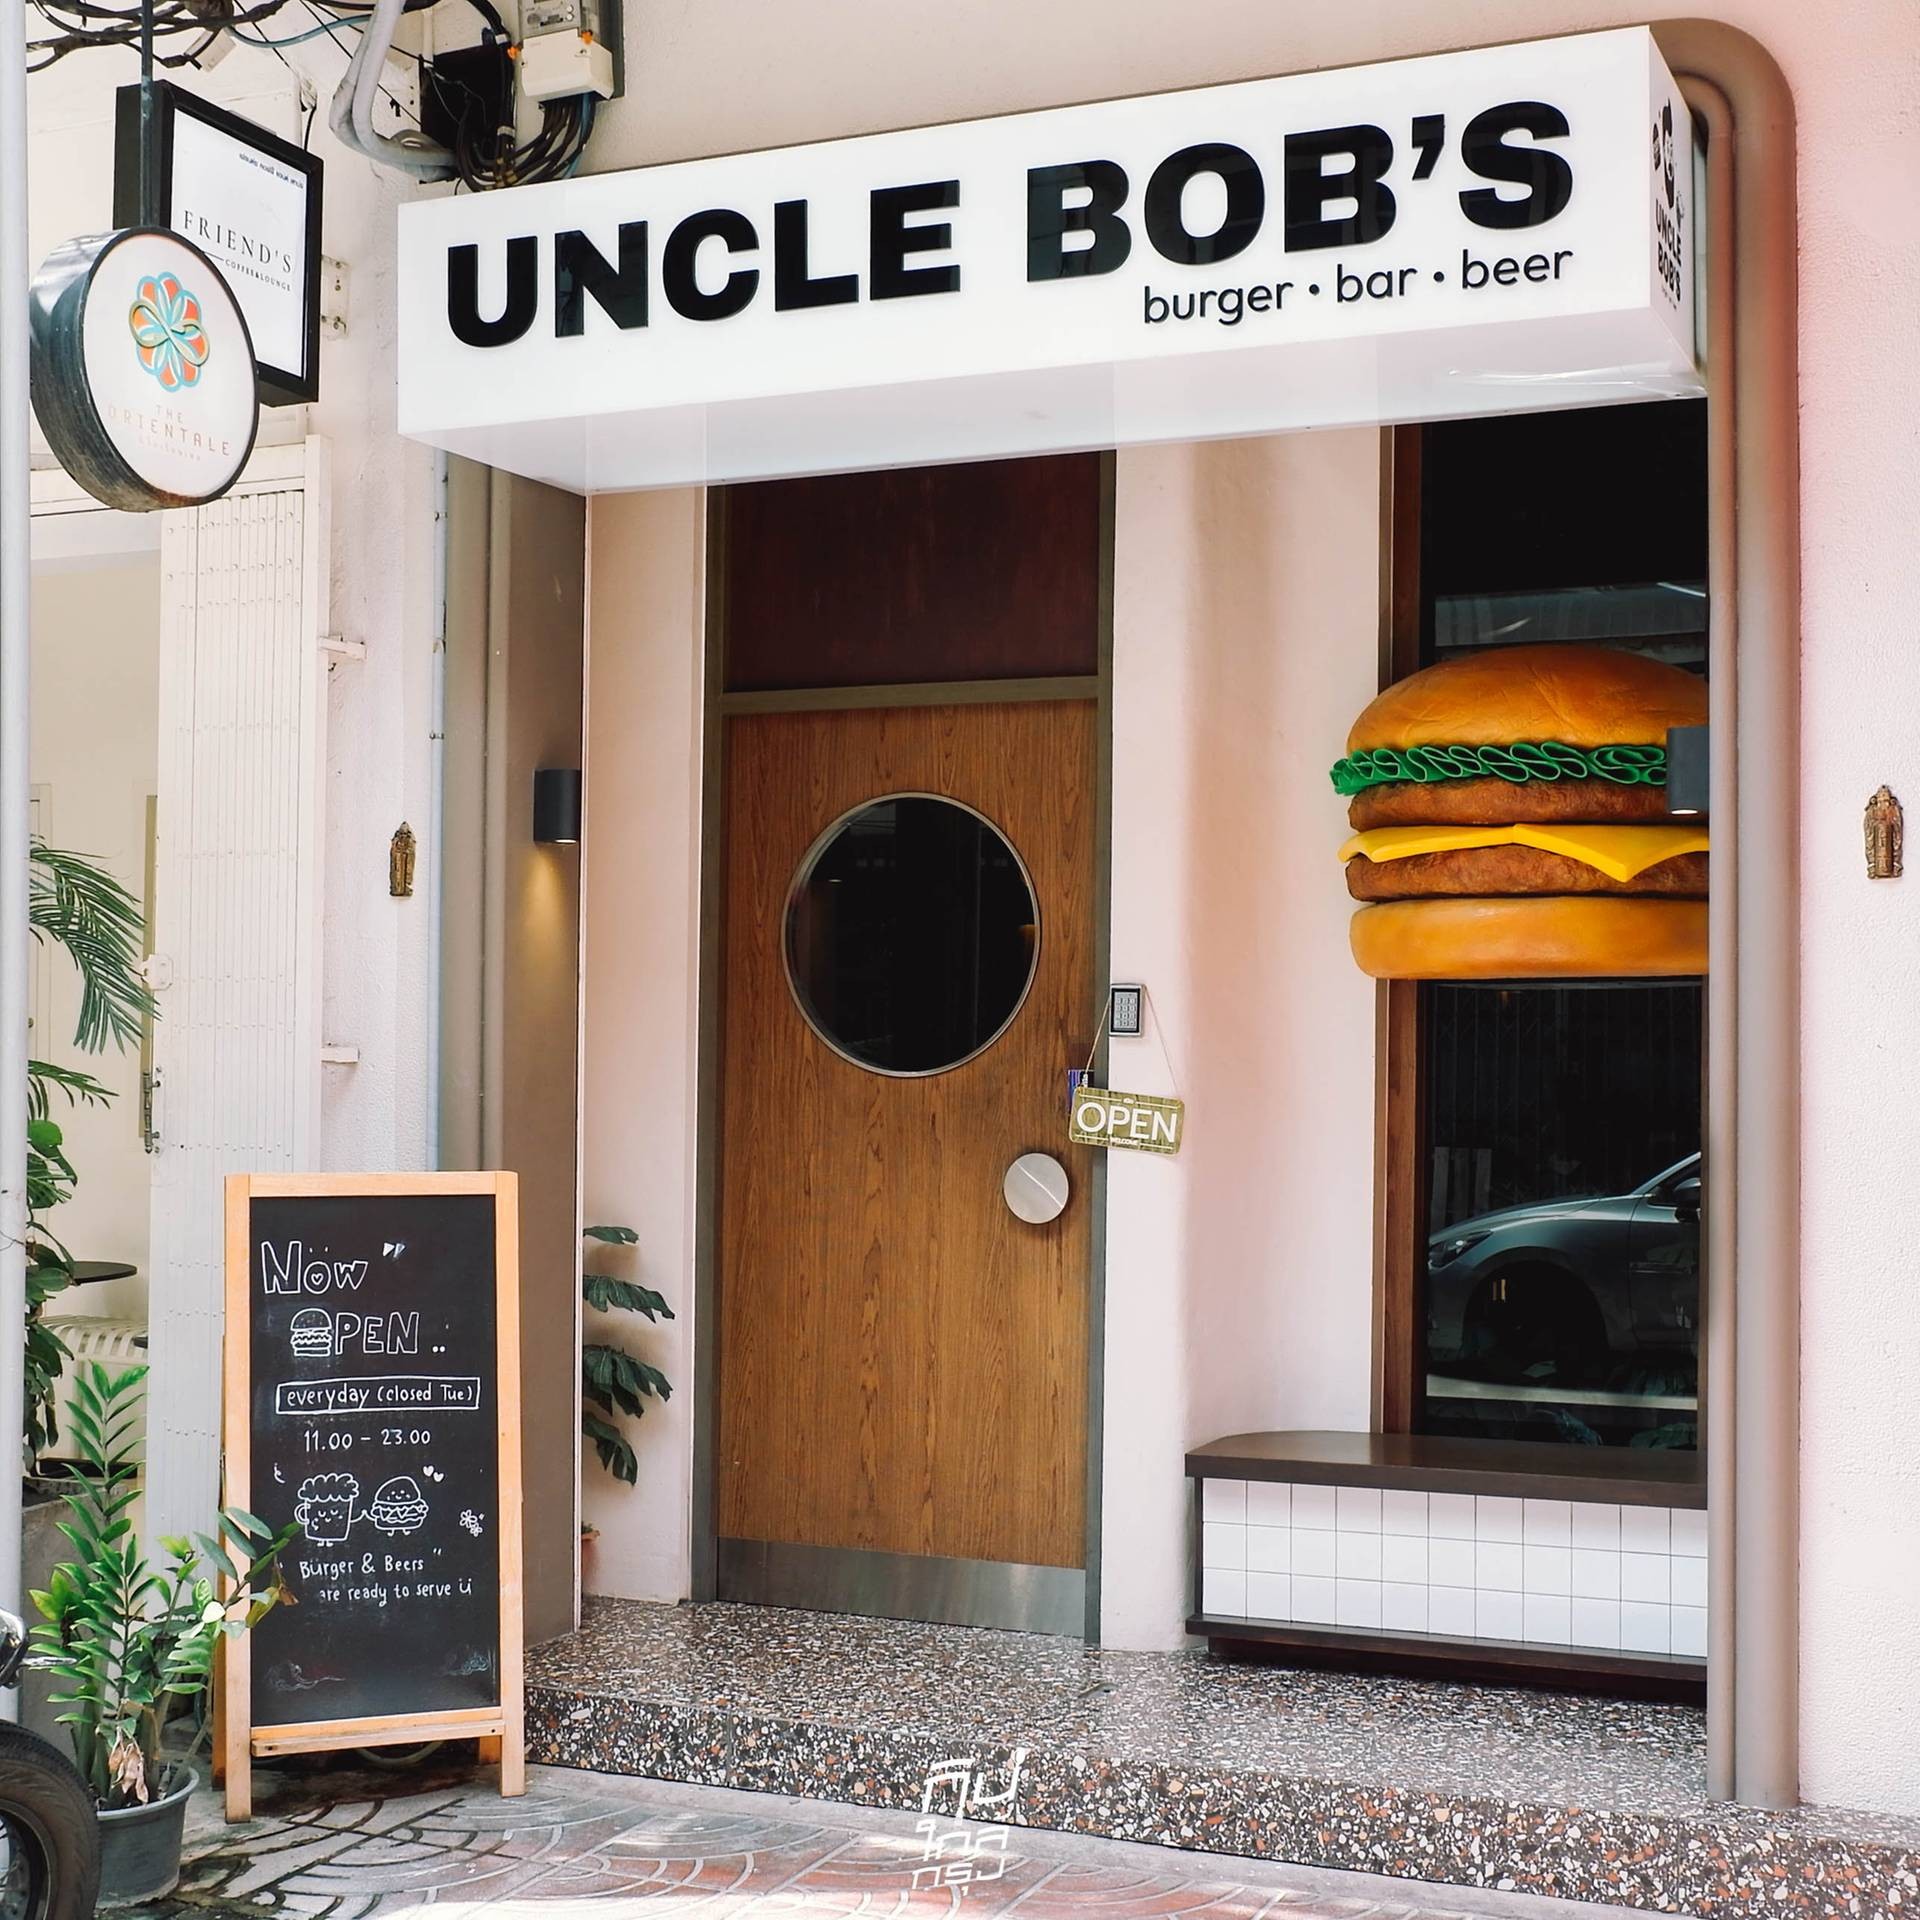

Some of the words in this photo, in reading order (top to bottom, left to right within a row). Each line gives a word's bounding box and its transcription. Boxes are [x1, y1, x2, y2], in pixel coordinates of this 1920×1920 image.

[183, 209, 292, 273] FRIEND'S
[447, 178, 961, 348] UNCLE
[1026, 100, 1574, 283] BOB'S
[1655, 197, 1682, 268] UNCLE
[1143, 278, 1294, 327] burger
[1336, 264, 1418, 303] bar
[1461, 249, 1574, 290] beer
[107, 405, 230, 457] ORIENTALE
[155, 404, 184, 424] THE
[1076, 1101, 1178, 1143] OPEN
[260, 1240, 368, 1295] Now
[287, 1383, 370, 1410] everyday
[377, 1382, 432, 1403] (closed
[440, 1384, 473, 1402] Tue)
[303, 1430, 352, 1452] 11.00
[380, 1428, 431, 1446] 23.00
[360, 1552, 376, 1574] &
[384, 1554, 425, 1573] Beers
[319, 1587, 340, 1603] are
[348, 1582, 388, 1608] ready
[394, 1582, 410, 1599] to
[415, 1582, 452, 1597] serve
